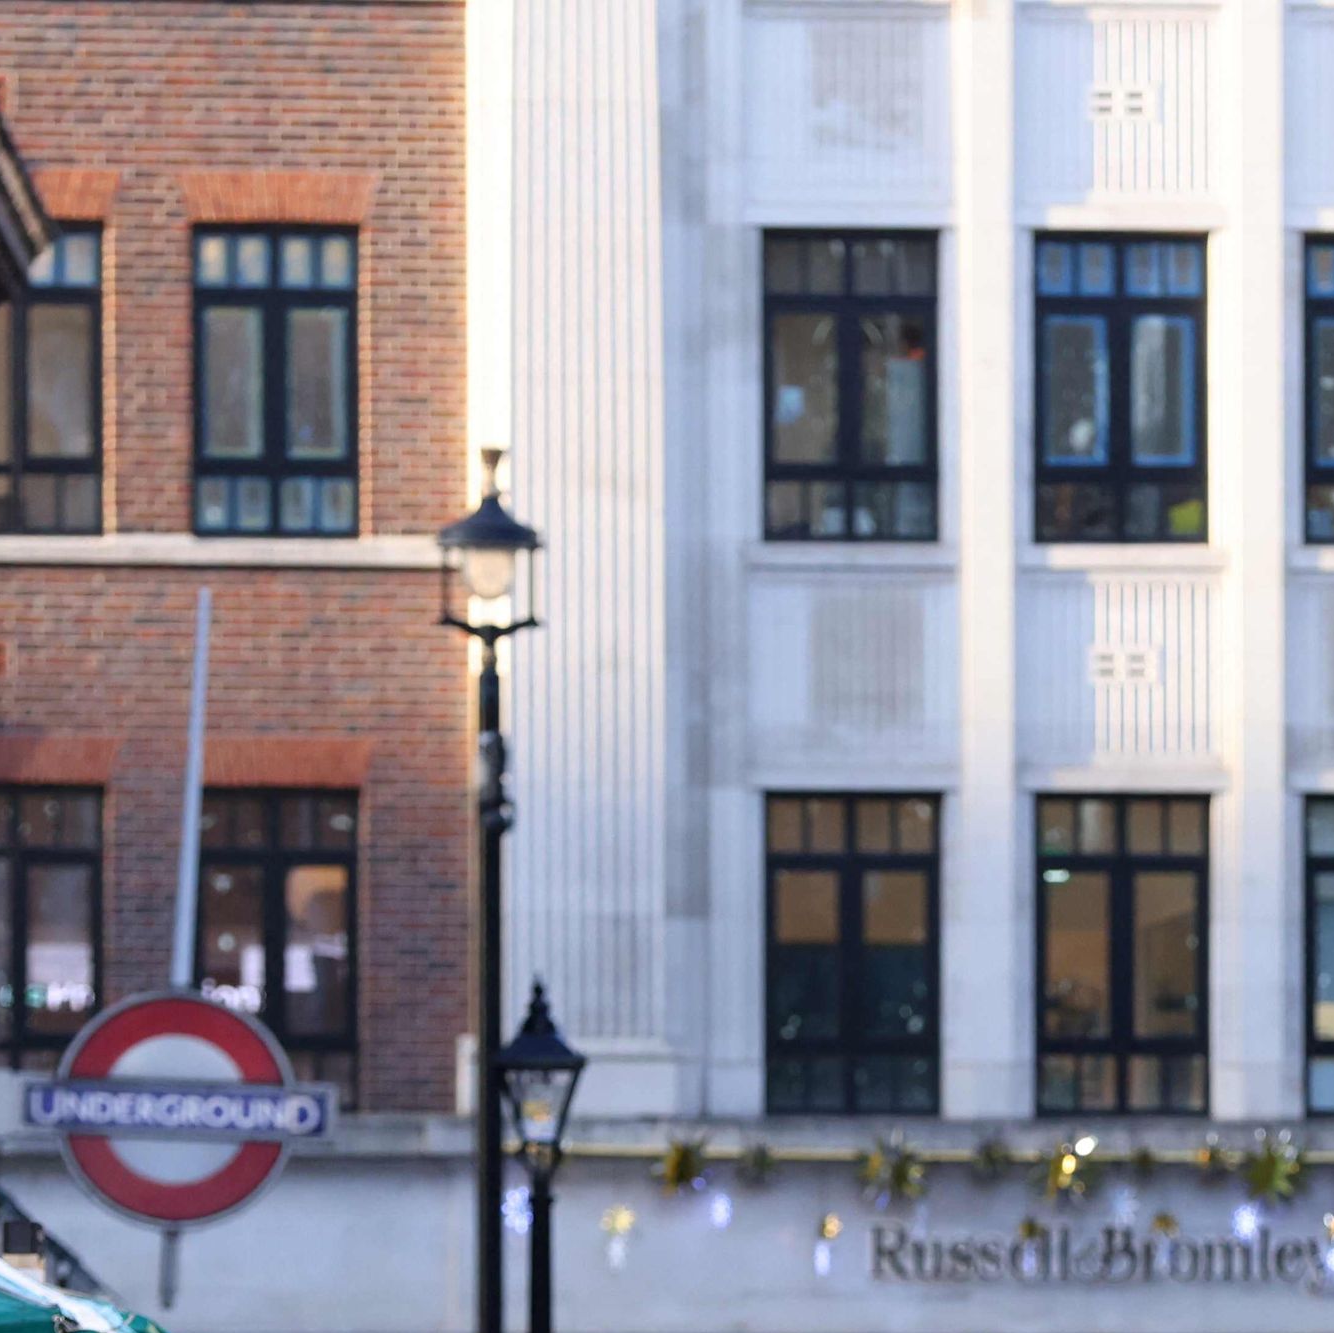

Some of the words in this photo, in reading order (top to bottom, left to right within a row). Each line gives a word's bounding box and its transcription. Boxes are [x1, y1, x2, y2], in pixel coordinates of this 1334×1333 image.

[30, 1086, 321, 1136] UNDERGROUND
[870, 1222, 1069, 1284] Russell
[1102, 1223, 1329, 1298] Bromley
